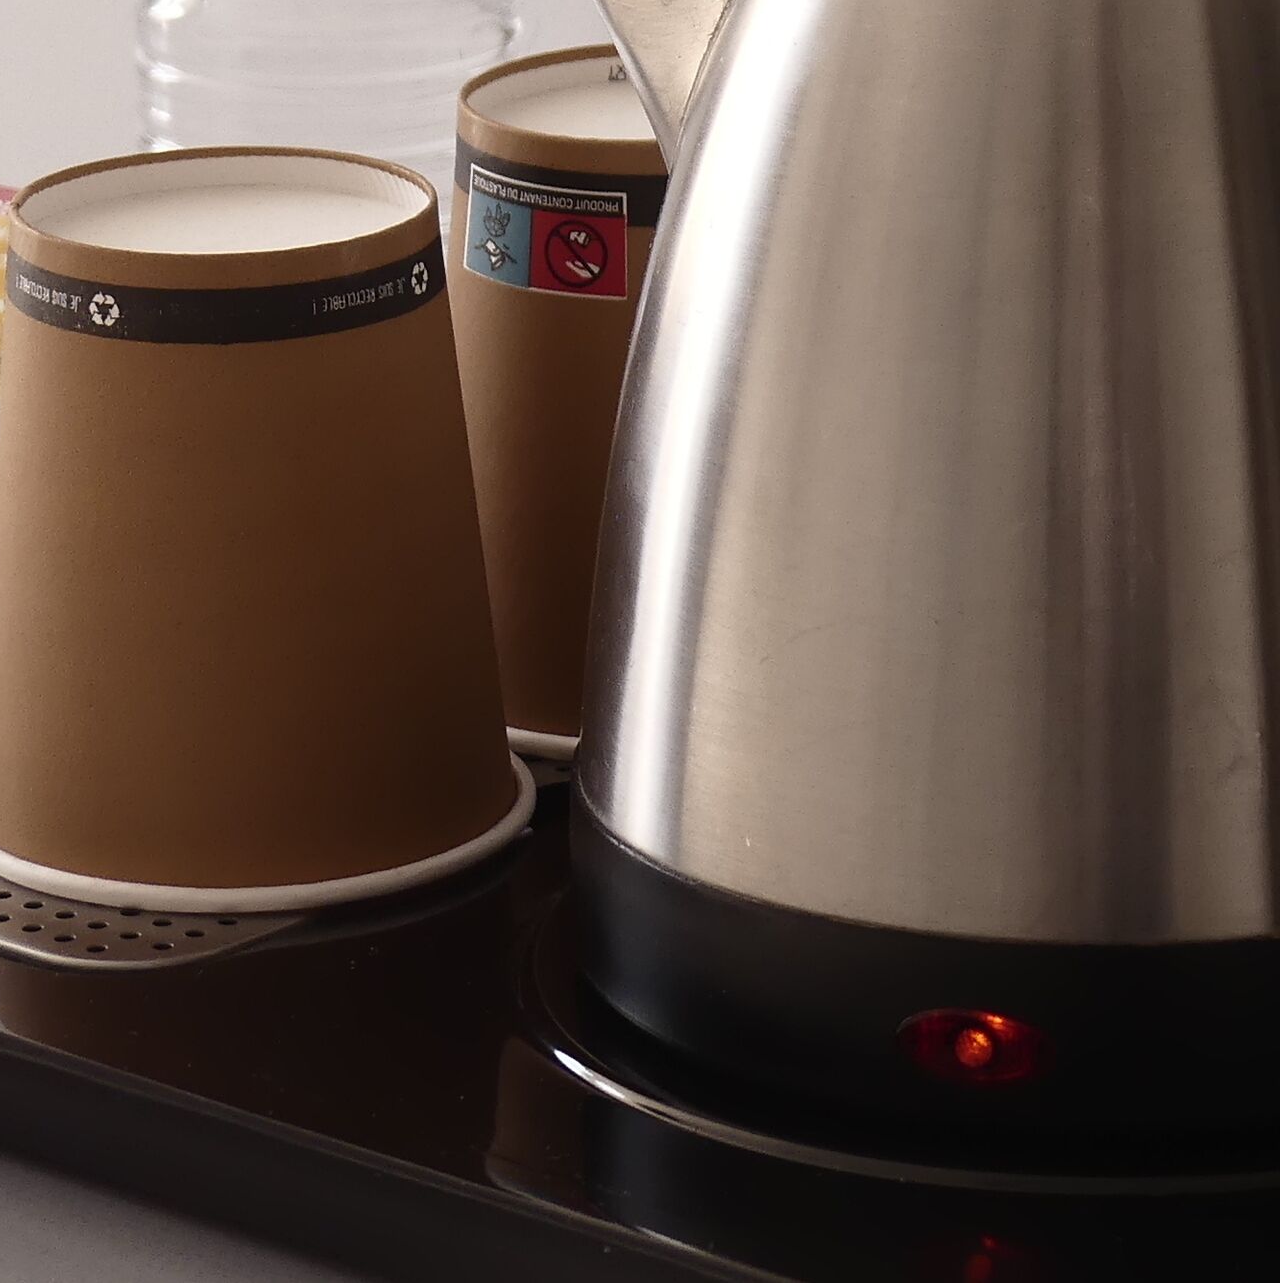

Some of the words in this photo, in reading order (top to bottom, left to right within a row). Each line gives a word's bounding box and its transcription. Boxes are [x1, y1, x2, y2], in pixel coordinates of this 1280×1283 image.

[507, 187, 519, 201] DU
[520, 190, 574, 211] CONTENANT
[575, 198, 619, 213] PRODUIT
[70, 295, 82, 313] JE
[322, 288, 376, 313] RECYCLABLE
